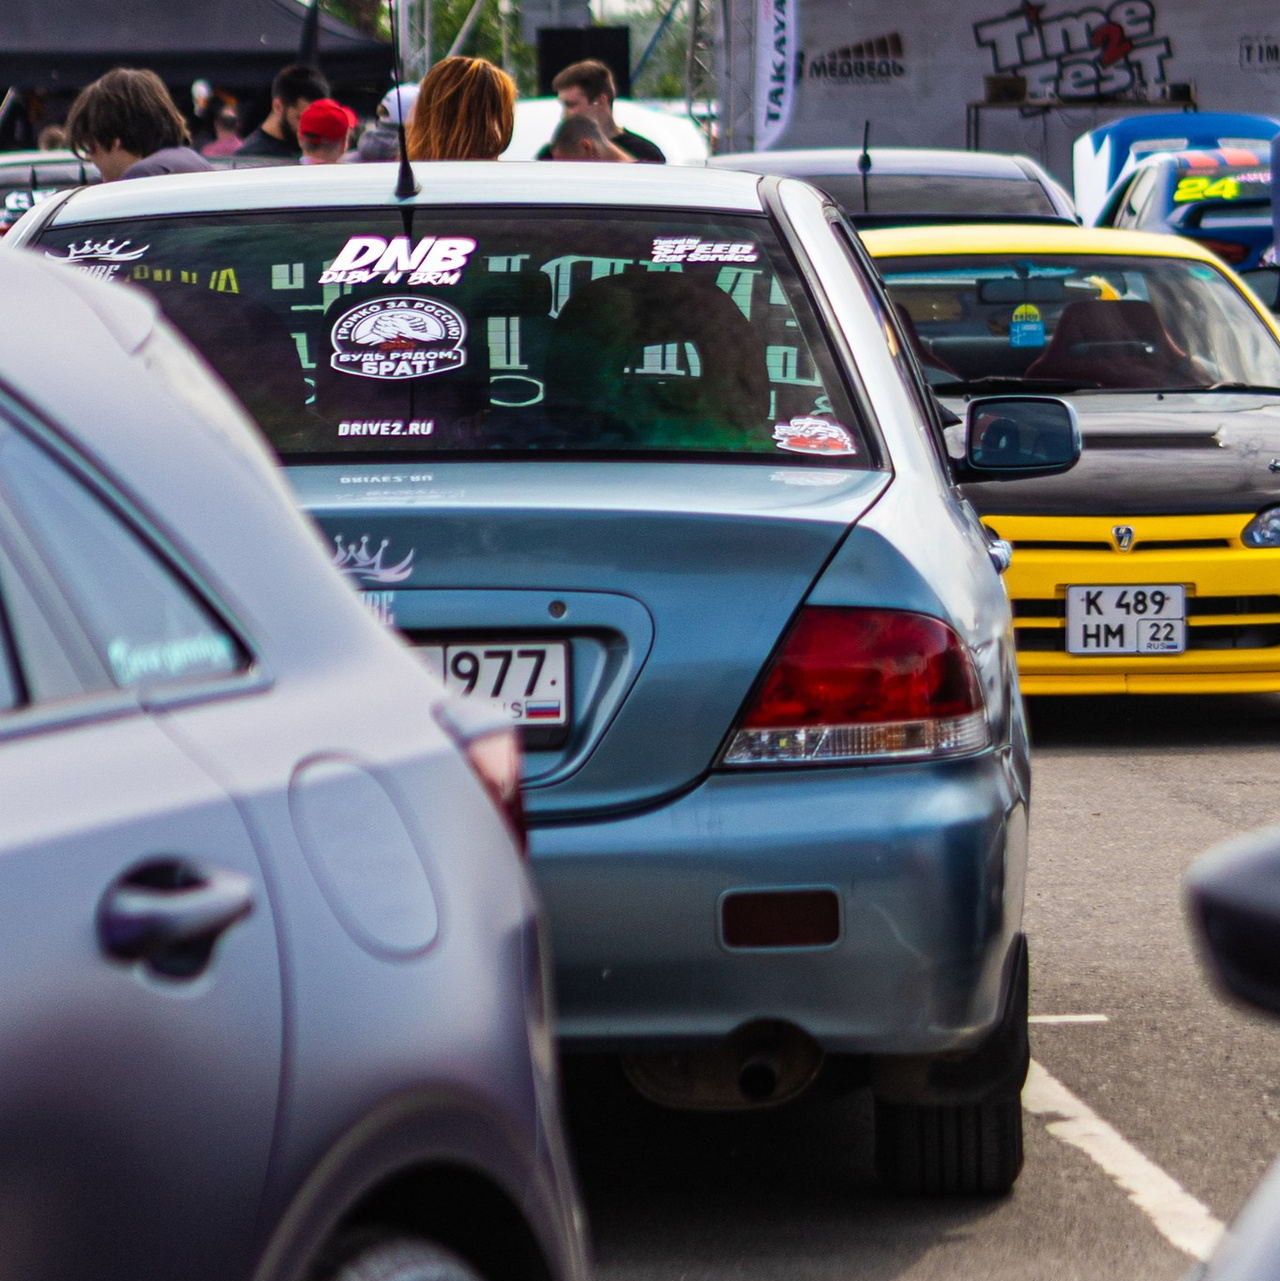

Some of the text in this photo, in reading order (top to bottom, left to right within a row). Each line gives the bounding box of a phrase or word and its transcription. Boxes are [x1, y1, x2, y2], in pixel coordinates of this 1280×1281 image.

[1173, 175, 1239, 202] 24
[328, 235, 478, 272] DNB
[651, 242, 756, 254] SPEED
[337, 300, 460, 341] ГРОМКО ЗА РОССИЮ!
[339, 349, 458, 363] БУДЬ РЯДОМ,
[361, 358, 436, 376] БРАТ!
[338, 422, 433, 436] DRIVE2.RU
[1115, 590, 1166, 616] 489
[1149, 622, 1174, 642] 22
[1146, 642, 1166, 650] RUS
[450, 649, 546, 698] 977
